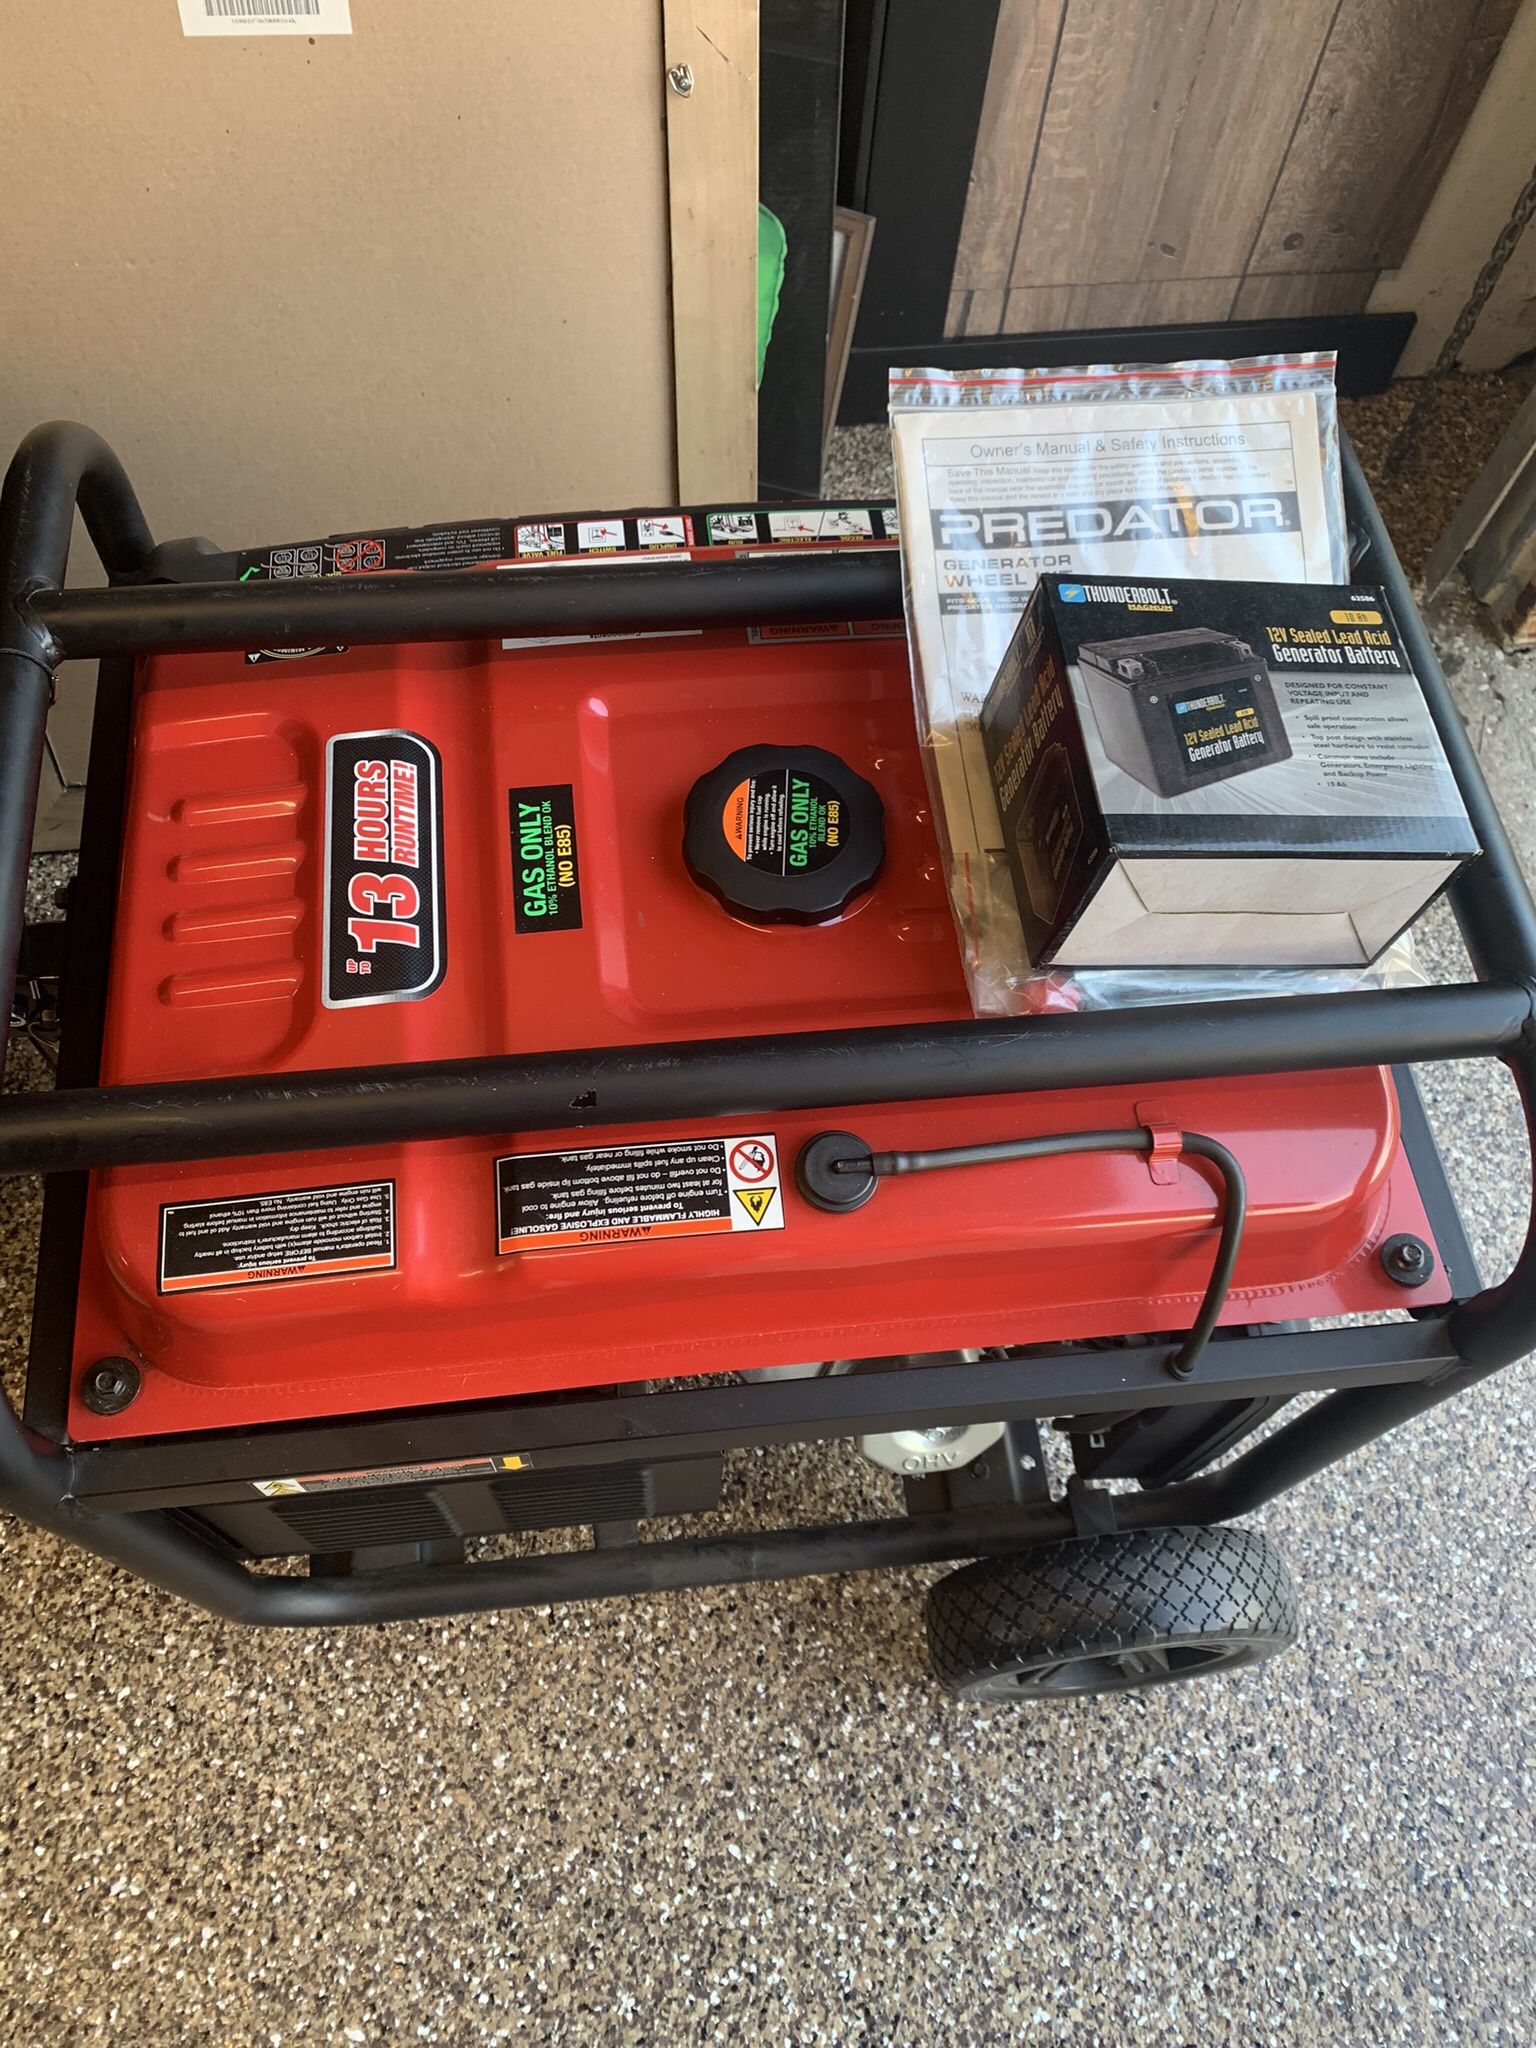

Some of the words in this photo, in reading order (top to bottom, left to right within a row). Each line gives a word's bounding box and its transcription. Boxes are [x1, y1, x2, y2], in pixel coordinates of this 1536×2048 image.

[970, 442, 1032, 458] Owner's
[1036, 439, 1090, 455] Manual
[1095, 439, 1106, 453] &
[1111, 437, 1158, 453] Safety
[1162, 432, 1246, 449] Instructions
[946, 467, 971, 478] Save
[974, 466, 993, 477] This
[995, 465, 1031, 476] Manual
[938, 498, 1285, 545] PREDATOR
[943, 554, 1072, 571] GENERATOR
[946, 572, 1026, 588] WHEEL
[1083, 585, 1171, 605] THUNDERBOLT
[1127, 603, 1173, 612] MAGNUM
[769, 624, 831, 635] WARNING
[1266, 627, 1287, 643] 12V
[1290, 628, 1332, 644] Sealed
[1334, 630, 1363, 645] Lead
[1365, 631, 1391, 646] Acid
[1272, 645, 1343, 664] Generator
[1346, 648, 1400, 667] Battery
[1184, 731, 1198, 746] 12V
[1198, 725, 1225, 741] Sealed
[1224, 720, 1243, 735] Lead
[1242, 716, 1259, 730] Acid
[999, 737, 1034, 812] Generator
[1032, 683, 1064, 749] Battery
[1188, 739, 1232, 762] Generator
[1232, 731, 1264, 750] Battery
[542, 800, 552, 813] OK
[777, 793, 785, 816] refueling.
[790, 777, 810, 823] ONLY
[354, 760, 389, 862] HOURS
[390, 760, 419, 868] RUNTIME!
[735, 797, 743, 833] WARNING
[809, 796, 818, 830] ETHANOL
[818, 804, 826, 815] OK
[826, 800, 840, 823] E85)
[518, 801, 543, 860] ONLY
[542, 815, 554, 845] BLEND
[817, 816, 826, 841] BLEND
[554, 823, 573, 856] E85)
[808, 831, 816, 847] 10%
[825, 827, 839, 846] (NO
[789, 829, 808, 866] GAS
[544, 847, 556, 891] ETHANOL
[556, 860, 575, 887] (NO
[521, 866, 547, 916] GAS
[547, 894, 558, 915] 10%
[348, 872, 420, 953] 13
[346, 958, 358, 974] UP
[359, 961, 372, 975] TO
[633, 1158, 653, 1169] spills
[654, 1158, 666, 1167] fuel
[666, 1155, 684, 1164] any
[686, 1154, 696, 1163] up
[697, 1154, 720, 1163] Clean
[584, 1160, 631, 1173] immediately.
[581, 1206, 605, 1218] injury
[607, 1205, 638, 1216] serious
[639, 1200, 671, 1213] prevent
[672, 1201, 683, 1209] To
[545, 1212, 562, 1222] fire:
[563, 1210, 580, 1220] and
[631, 1210, 686, 1224] FLAMMABLE
[687, 1207, 720, 1218] HIGHLY
[560, 1217, 609, 1231] EXPLOSIVE
[610, 1215, 630, 1226] AND
[510, 1222, 558, 1236] GASOLINE!
[579, 1226, 640, 1241] WARNING
[312, 1244, 334, 1253] manual
[335, 1240, 364, 1250] operator's
[366, 1238, 381, 1246] Read
[246, 1252, 265, 1261] and/or
[266, 1249, 283, 1258] setup
[282, 1254, 306, 1263] prevent
[284, 1247, 311, 1256] BEFORE
[236, 1260, 256, 1269] injury:
[258, 1258, 281, 1267] serious
[247, 1265, 296, 1279] WARNING
[902, 1451, 960, 1471] OHV
